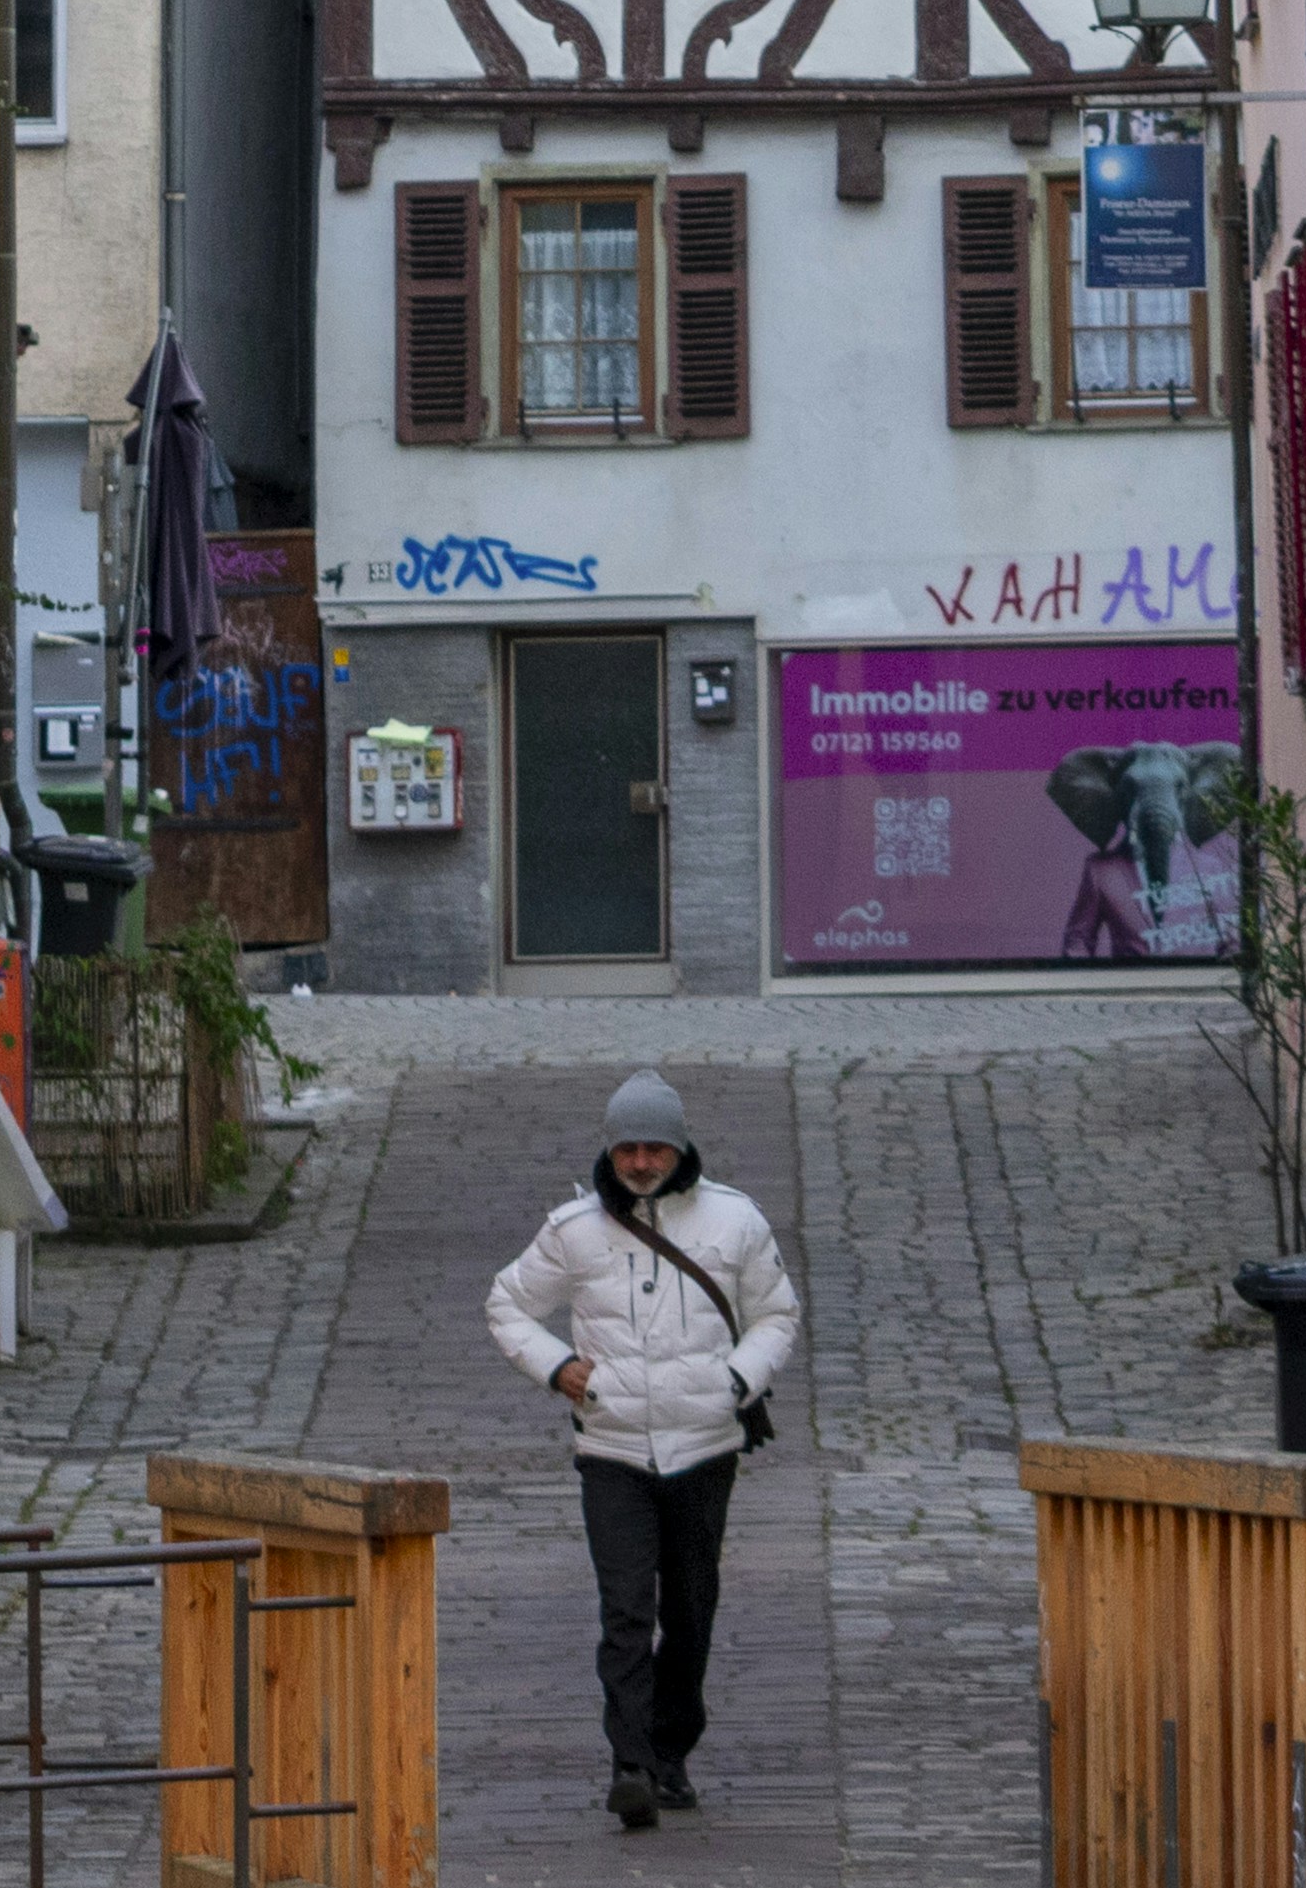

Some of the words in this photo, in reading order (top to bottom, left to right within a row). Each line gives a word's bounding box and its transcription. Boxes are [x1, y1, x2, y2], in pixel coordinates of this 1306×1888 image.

[811, 682, 988, 715] Immobilie
[997, 688, 1036, 712] zu
[1044, 678, 1240, 712] verkaufen.
[811, 731, 873, 753] 07121
[881, 730, 962, 752] 159560
[813, 926, 909, 952] elephas
